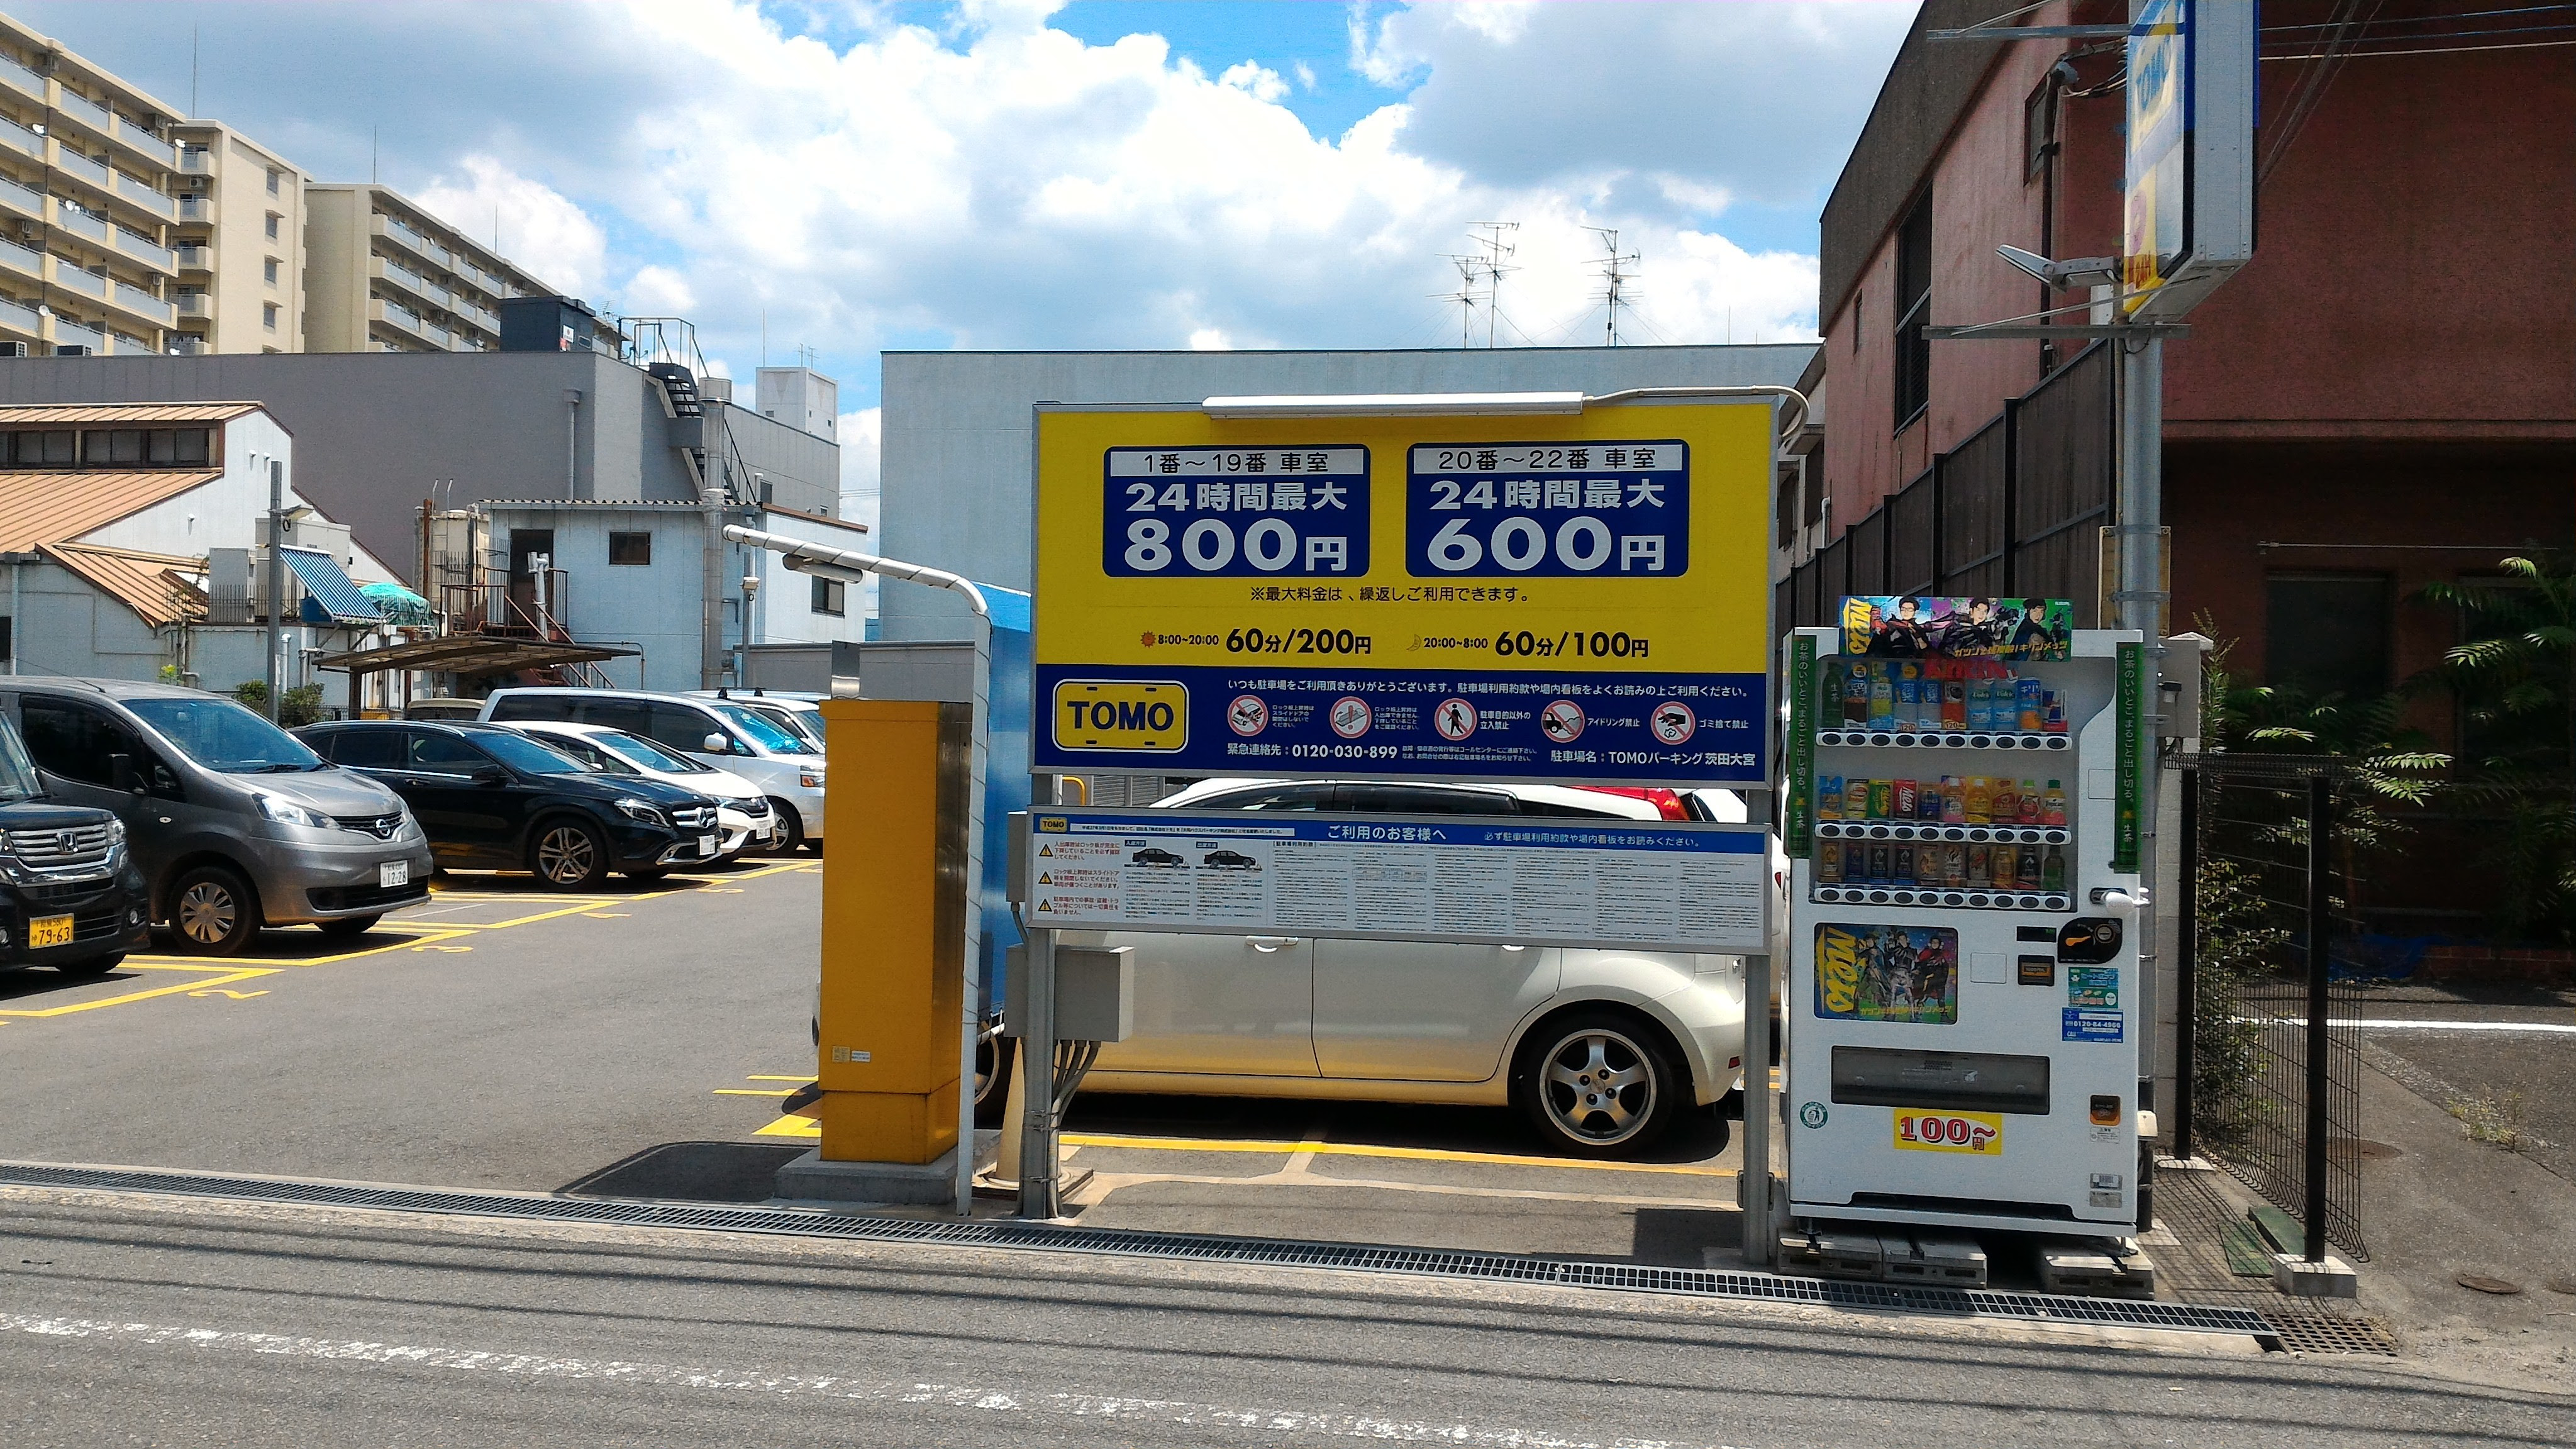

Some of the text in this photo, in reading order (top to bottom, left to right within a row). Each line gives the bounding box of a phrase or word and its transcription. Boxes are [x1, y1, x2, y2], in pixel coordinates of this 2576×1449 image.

[1280, 452, 1329, 472] 車室
[1604, 448, 1657, 469] 車室
[1125, 482, 1347, 511] 24時間最大
[1429, 478, 1665, 510] 24時間最大
[1124, 518, 1347, 571] 800円
[1427, 516, 1665, 571] 600円
[1226, 628, 1372, 654] 60分/200円
[1495, 630, 1649, 657] 60分/100円
[1067, 701, 1174, 731] TOMO
[1480, 721, 1509, 730] 立入禁止
[1587, 717, 1641, 728] アイドリング禁止
[1699, 719, 1749, 729] ゴミ捨て禁止
[1042, 820, 1065, 828] TOMO
[1328, 824, 1446, 841] ご利用のお客様へ
[2123, 824, 2133, 842] 生茶
[39, 926, 70, 945] 79-63
